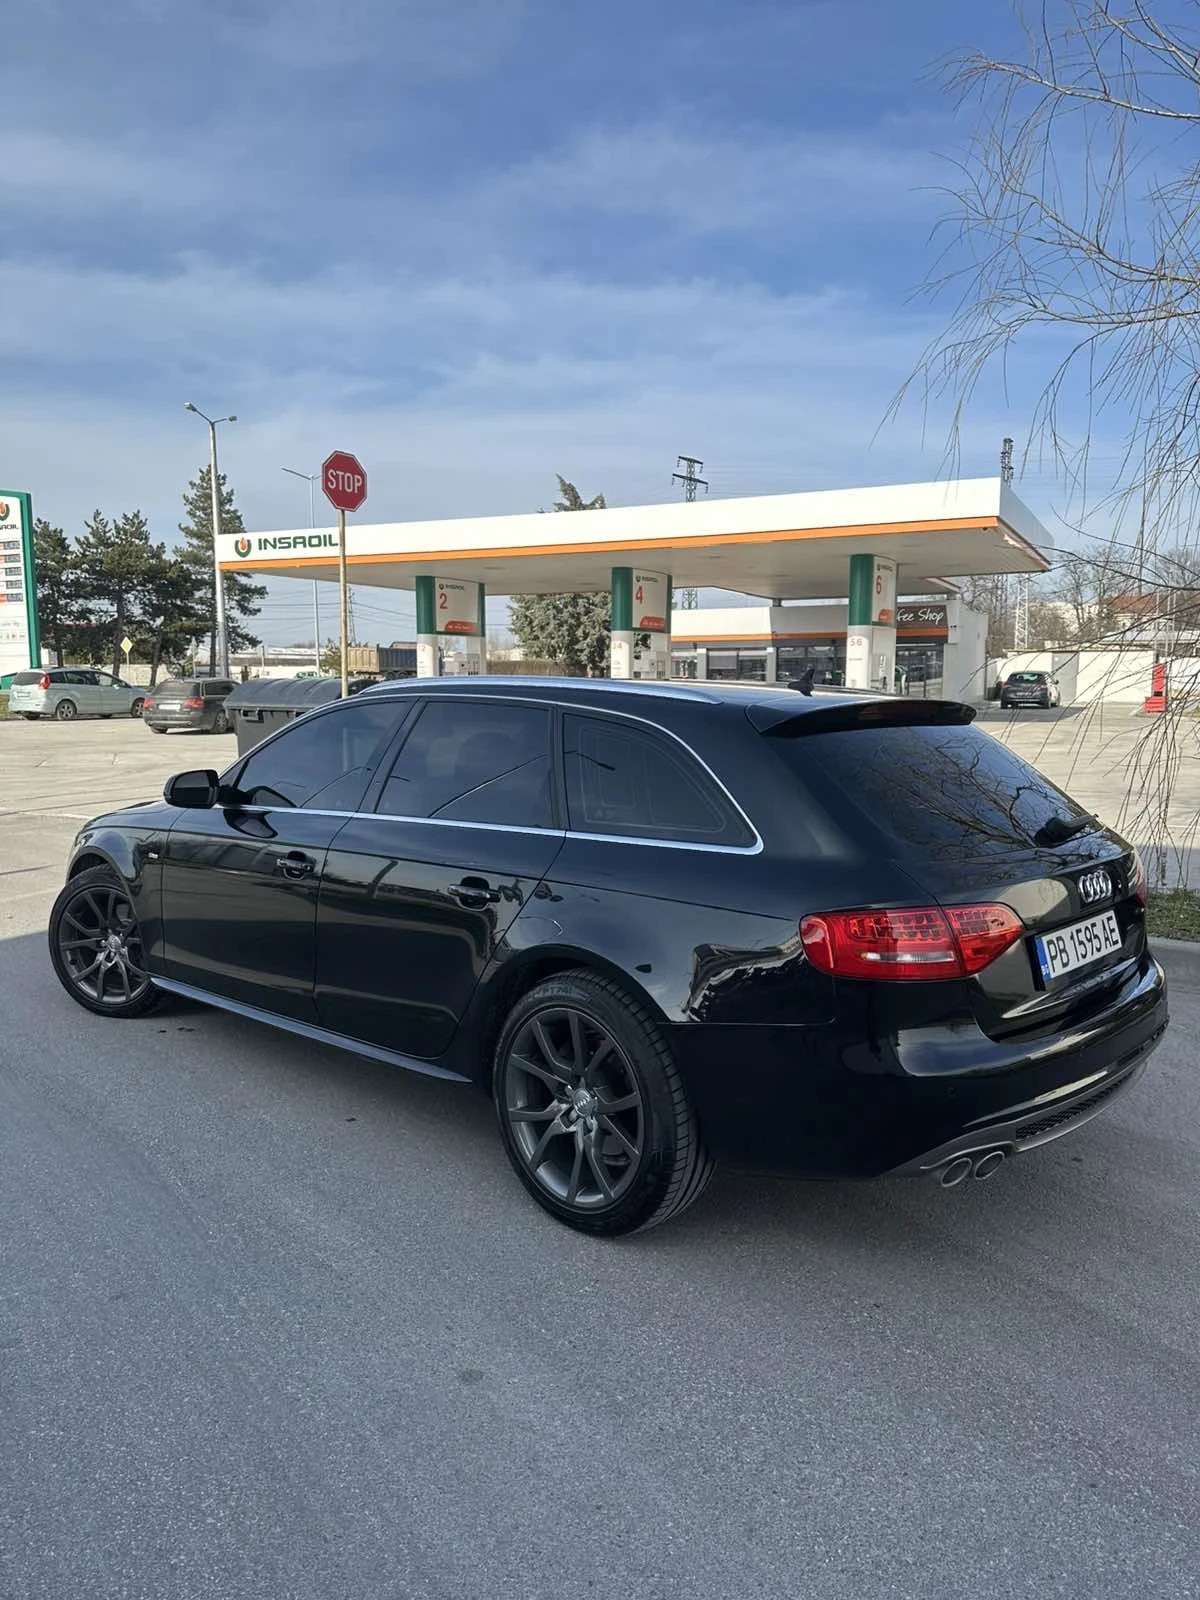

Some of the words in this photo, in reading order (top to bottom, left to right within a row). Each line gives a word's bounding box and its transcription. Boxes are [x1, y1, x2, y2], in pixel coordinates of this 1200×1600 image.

[328, 469, 362, 494] STOP
[258, 534, 339, 551] INSAOIL
[876, 575, 882, 594] 6
[439, 592, 448, 610] 2
[636, 586, 643, 605] 4
[918, 608, 944, 625] Shop
[1046, 936, 1070, 973] PB
[1070, 922, 1103, 962] 1595
[1101, 915, 1120, 949] AE
